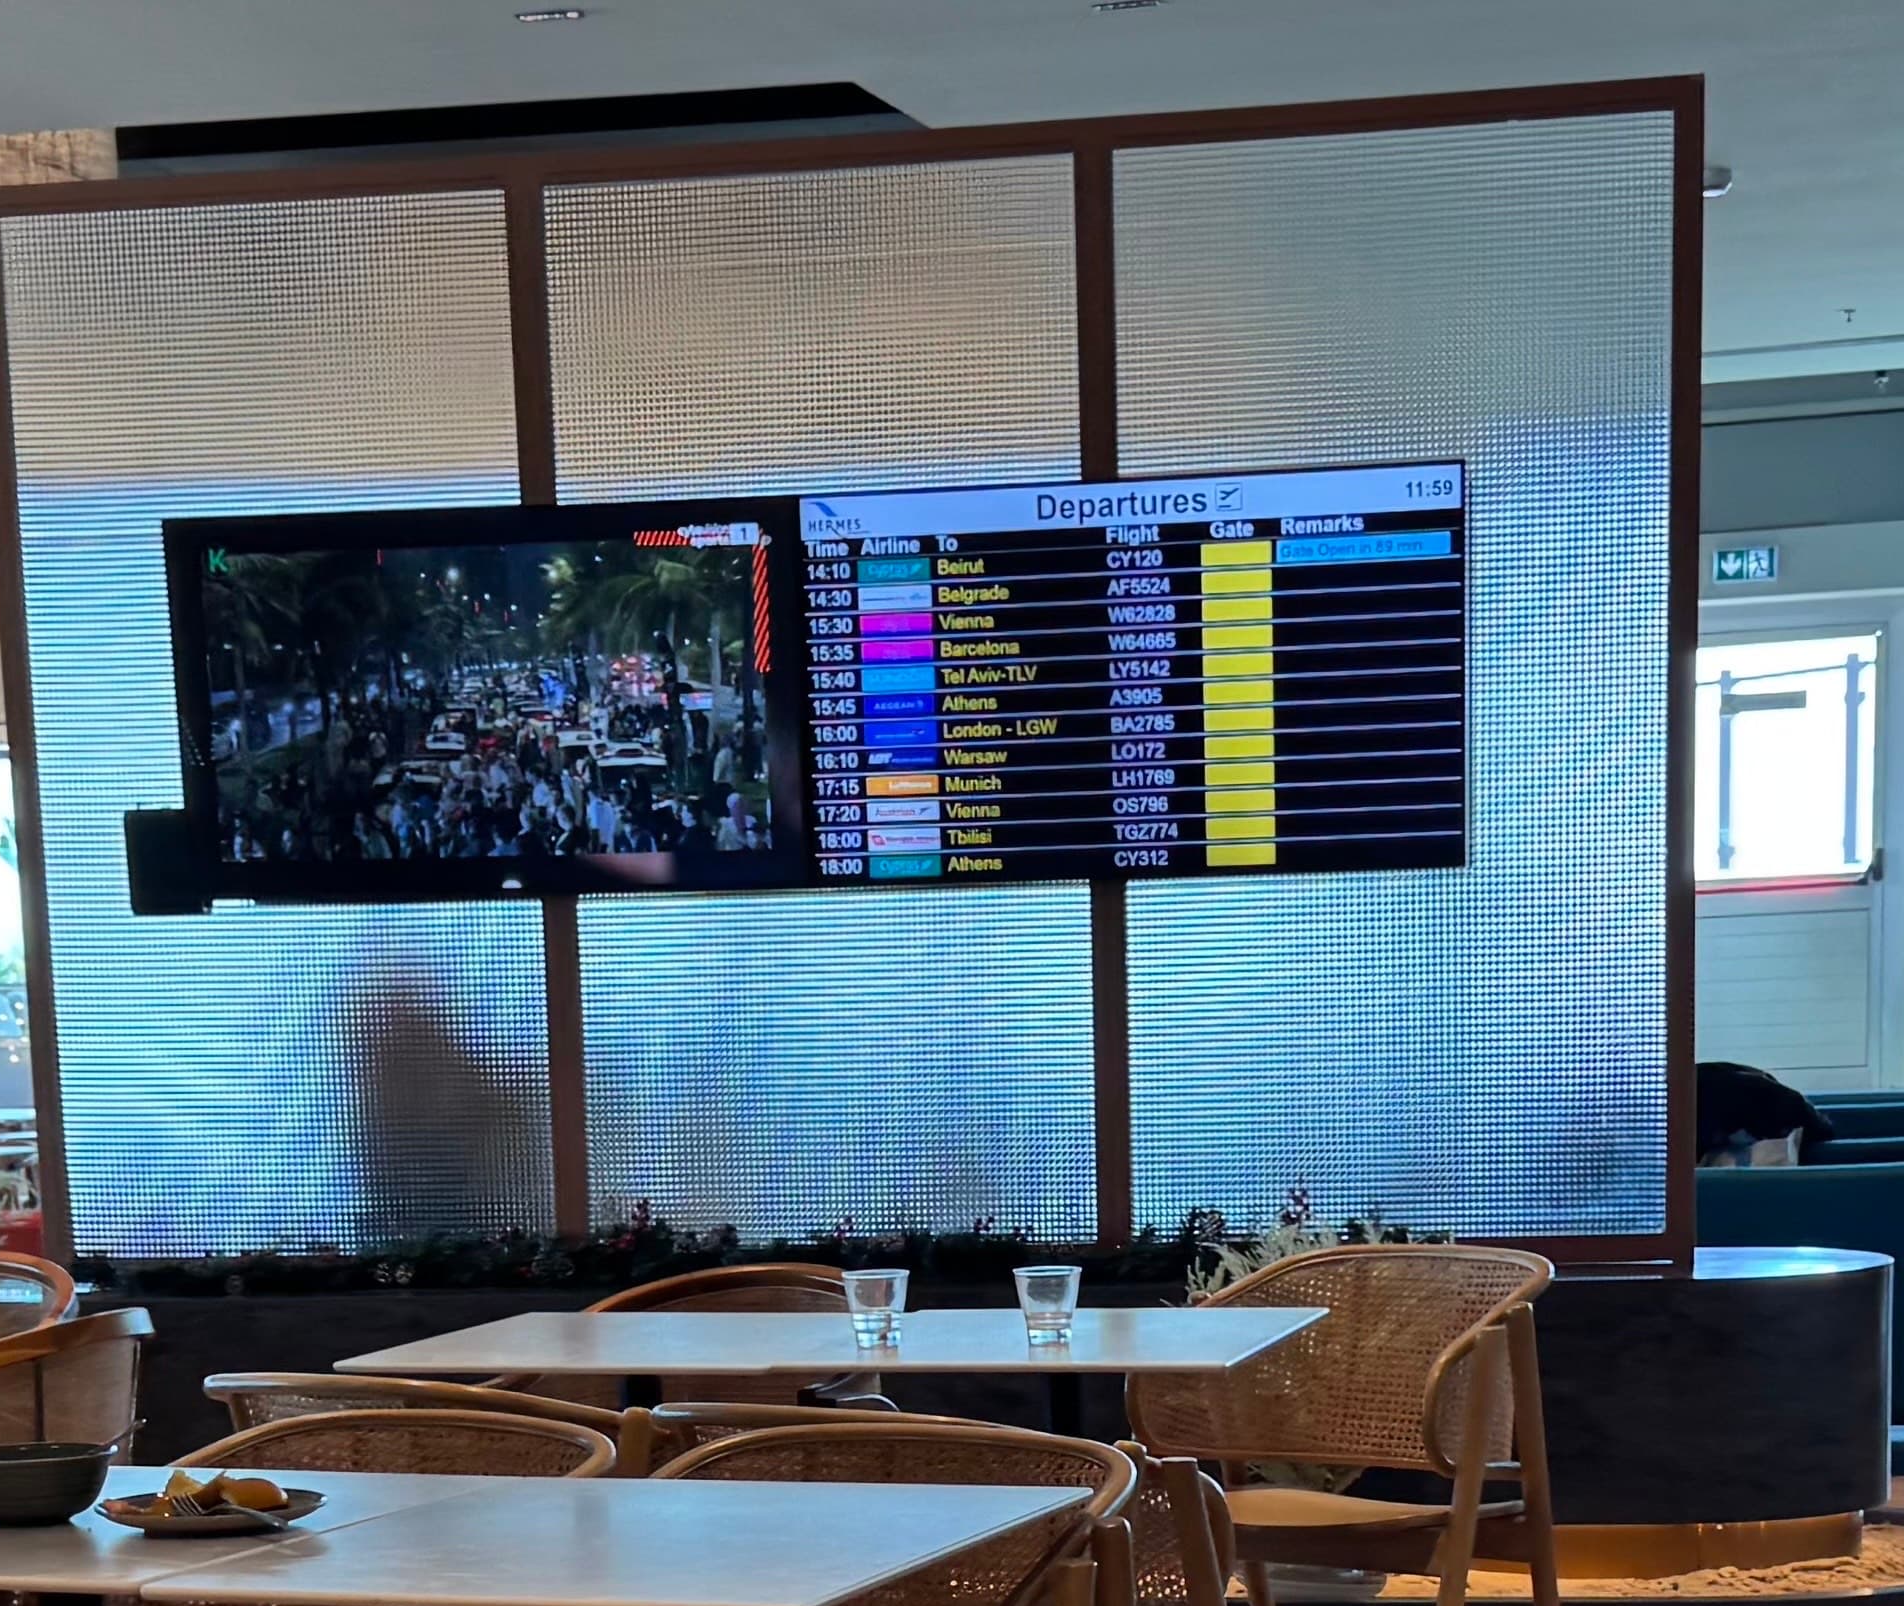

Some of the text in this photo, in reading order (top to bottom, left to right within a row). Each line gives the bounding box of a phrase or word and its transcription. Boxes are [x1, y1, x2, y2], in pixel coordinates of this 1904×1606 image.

[1405, 479, 1454, 498] 11:59
[1037, 491, 1208, 525] Departures
[804, 515, 1364, 558] Time Airline To Flight Gate Remarks
[808, 518, 862, 536] HERMES
[807, 562, 851, 580] 14:10
[937, 558, 985, 575] Beirut
[1106, 549, 1163, 568] CY120
[808, 576, 1171, 607] 14:30 Belgrade AF5524
[809, 616, 853, 635] 15:30
[939, 612, 995, 630] Vienna
[810, 645, 854, 662] 15:35
[940, 640, 1020, 658] Barcelona
[811, 671, 855, 689] 15:40
[941, 668, 964, 685] Tel
[967, 665, 1037, 683] Aviv-TLV
[1109, 661, 1171, 680] LY5142
[812, 698, 857, 716] 15:45
[942, 695, 998, 712] Athens
[1109, 687, 1163, 706] A3905
[814, 725, 857, 743] 16:00
[943, 721, 1002, 739] London
[1016, 718, 1058, 736] LGW
[1110, 714, 1175, 733] BA2785
[814, 752, 859, 769] 16:10
[944, 749, 1008, 766] Warsaw
[1111, 742, 1166, 760] LO172
[816, 779, 860, 795] 17:15
[945, 774, 1002, 792] Munich
[1112, 768, 1176, 787] LH1769
[817, 805, 861, 823] 17:20
[946, 802, 1001, 819] Vienna
[1113, 796, 1169, 814] OS796
[818, 831, 862, 849] 18:00
[947, 828, 993, 845] Tbilisi
[1113, 822, 1179, 841] TGZ774
[819, 857, 863, 875] 18:00
[948, 855, 1003, 873] Athens
[1114, 850, 1169, 867] CY312
